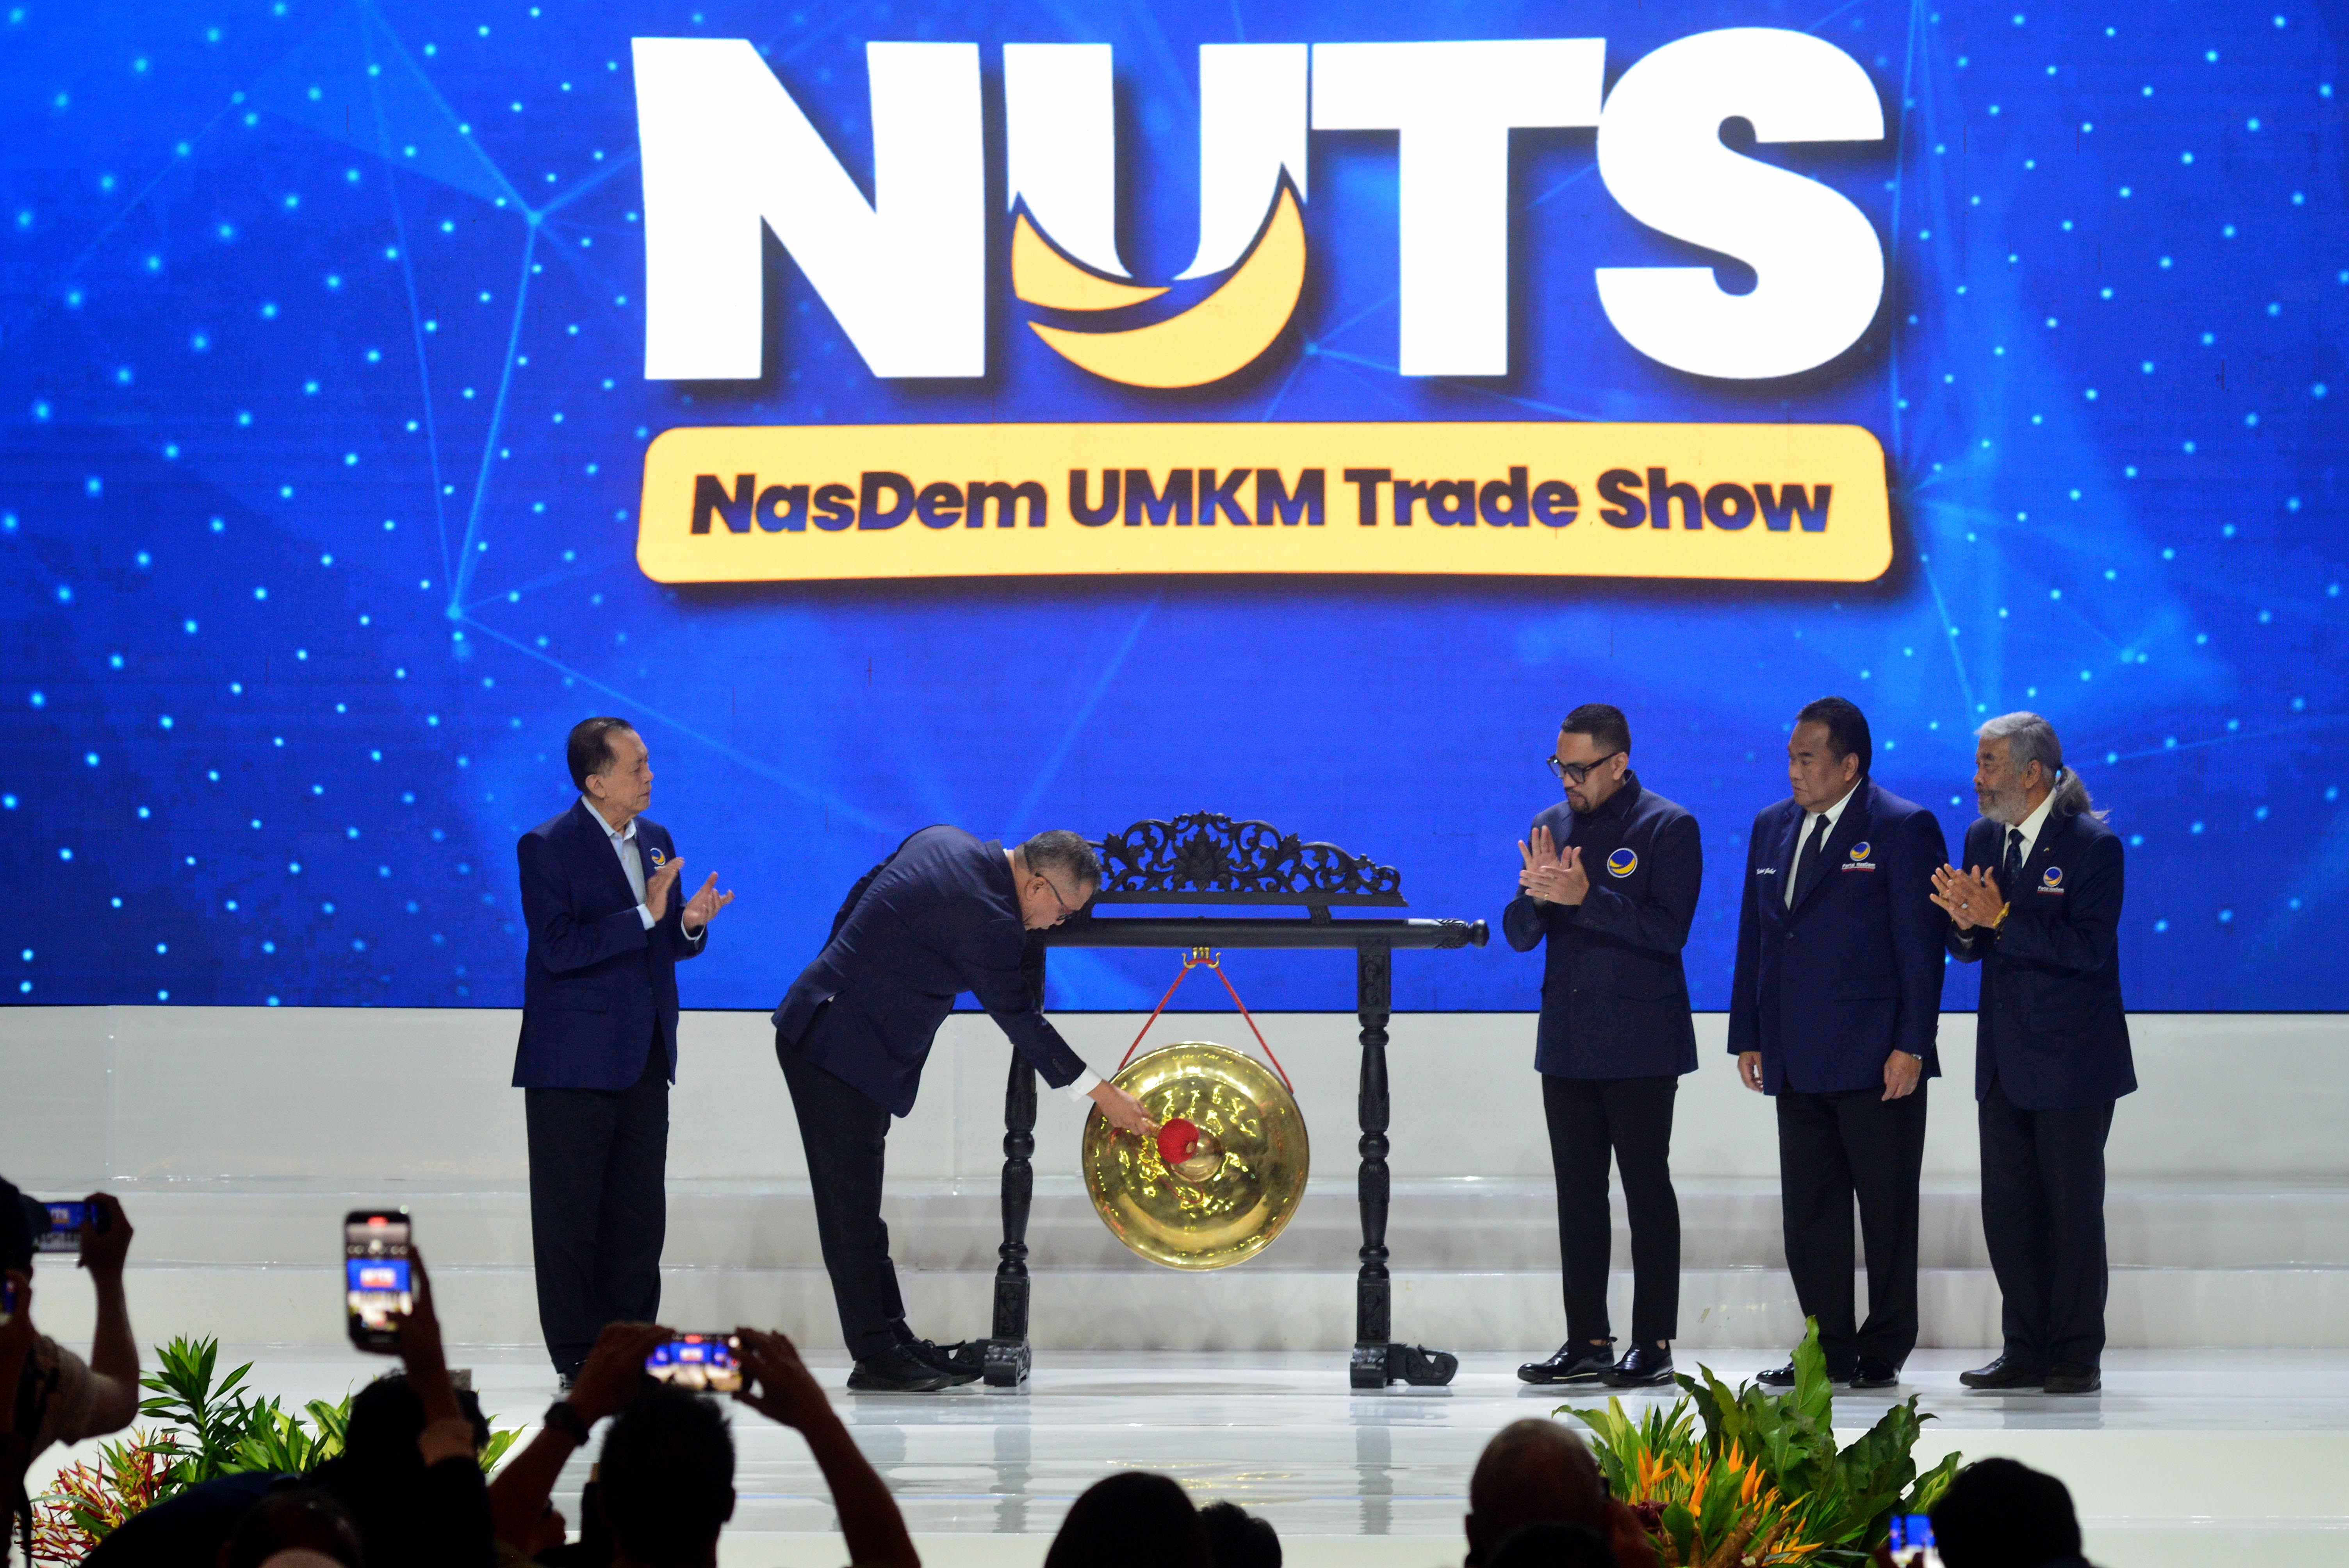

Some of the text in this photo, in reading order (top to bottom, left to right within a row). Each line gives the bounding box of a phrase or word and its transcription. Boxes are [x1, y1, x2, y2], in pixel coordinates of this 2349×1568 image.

[632, 27, 1885, 388] NUTS
[692, 467, 1832, 534] NasDem UMKM Trade Show
